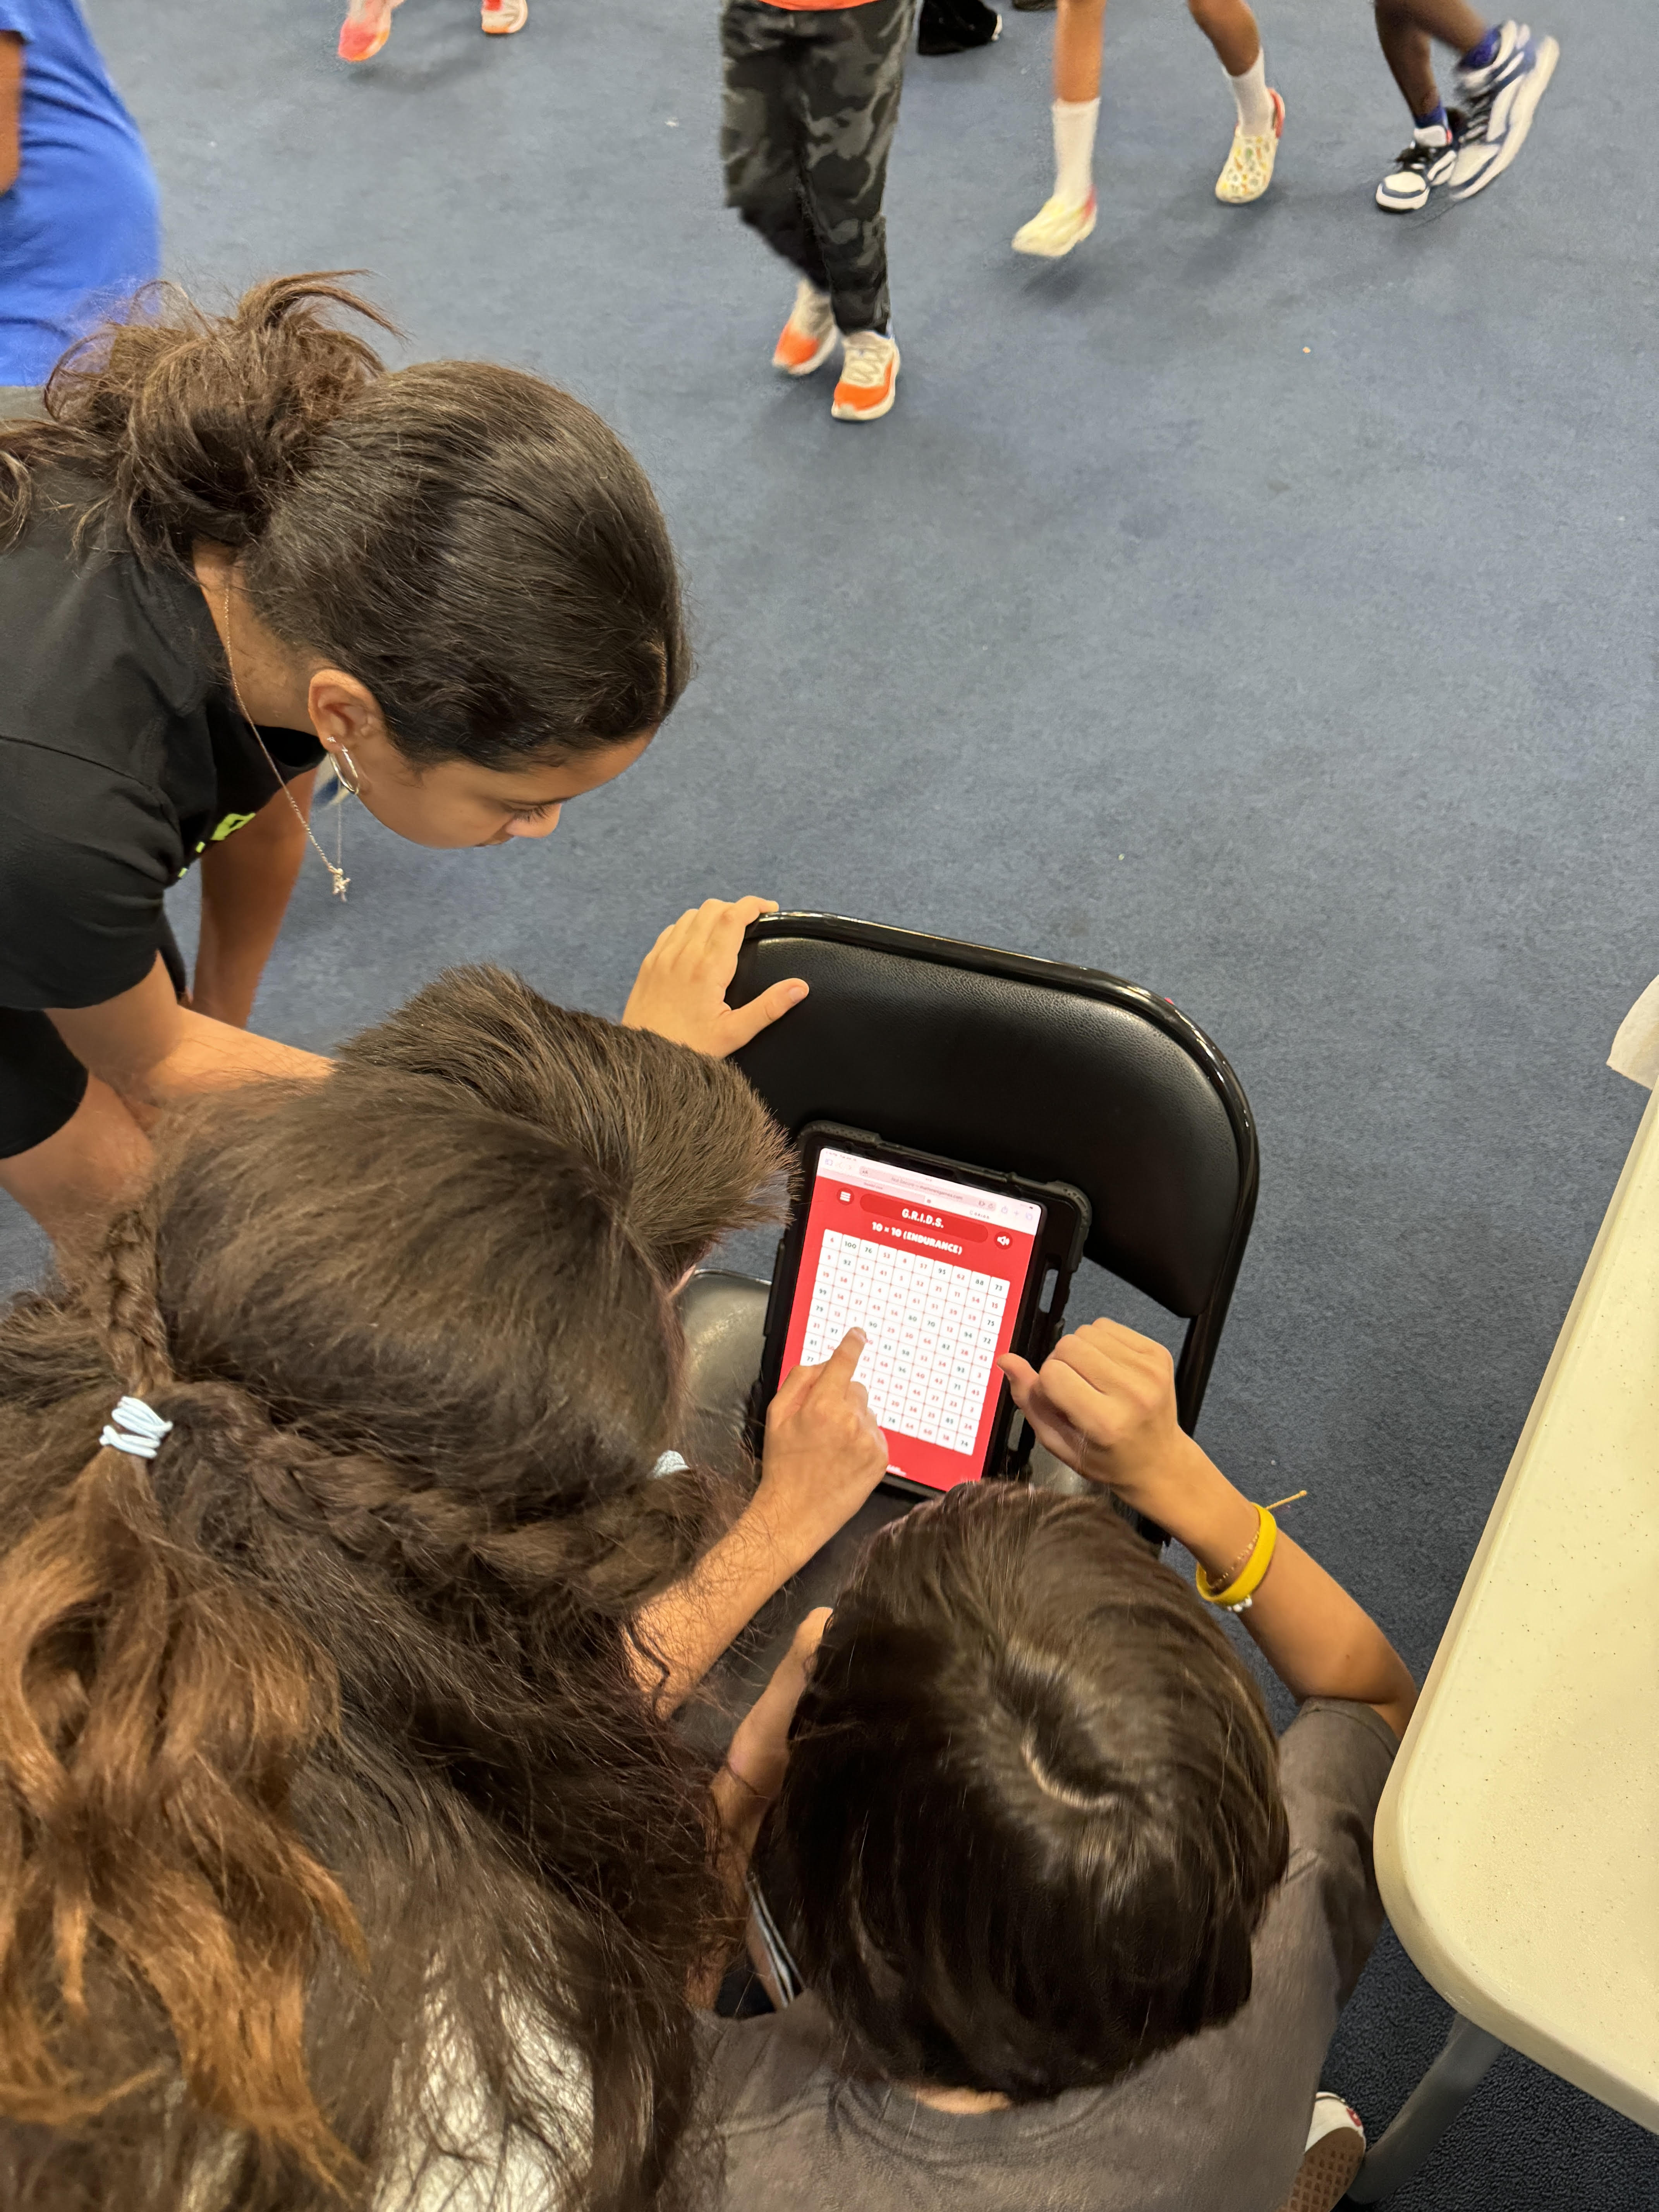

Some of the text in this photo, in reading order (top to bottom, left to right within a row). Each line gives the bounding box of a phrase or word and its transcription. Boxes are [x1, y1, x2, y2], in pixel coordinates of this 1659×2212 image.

[902, 1208, 944, 1228] G.R.I.D.S.
[872, 1221, 883, 1232] 10
[891, 1227, 902, 1237] 10
[903, 1231, 962, 1255] (ENDURANCE)
